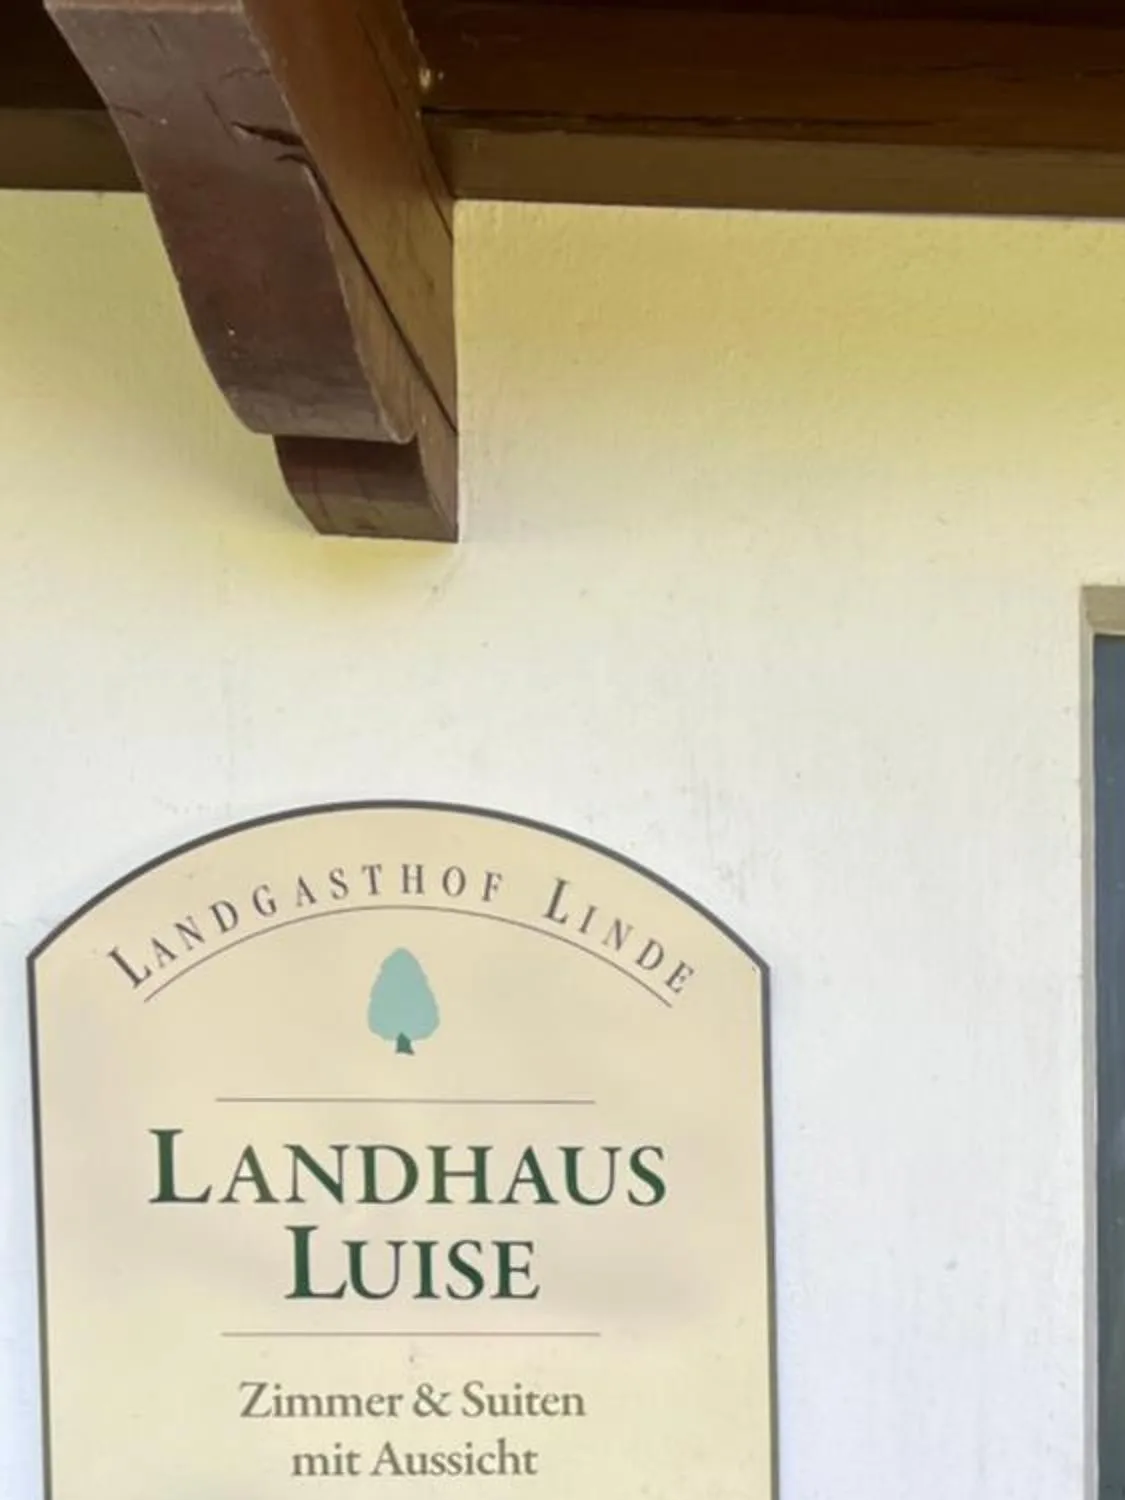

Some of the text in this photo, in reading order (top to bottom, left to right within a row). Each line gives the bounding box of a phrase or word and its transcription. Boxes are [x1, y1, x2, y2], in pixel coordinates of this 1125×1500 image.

[107, 863, 696, 996] LANDGASTHOF LINDE
[147, 1128, 668, 1207] LANDHAUS
[284, 1225, 541, 1300] LUISE
[238, 1380, 587, 1419] Zimmer & Suiten
[291, 1438, 539, 1478] mit Aussicht
